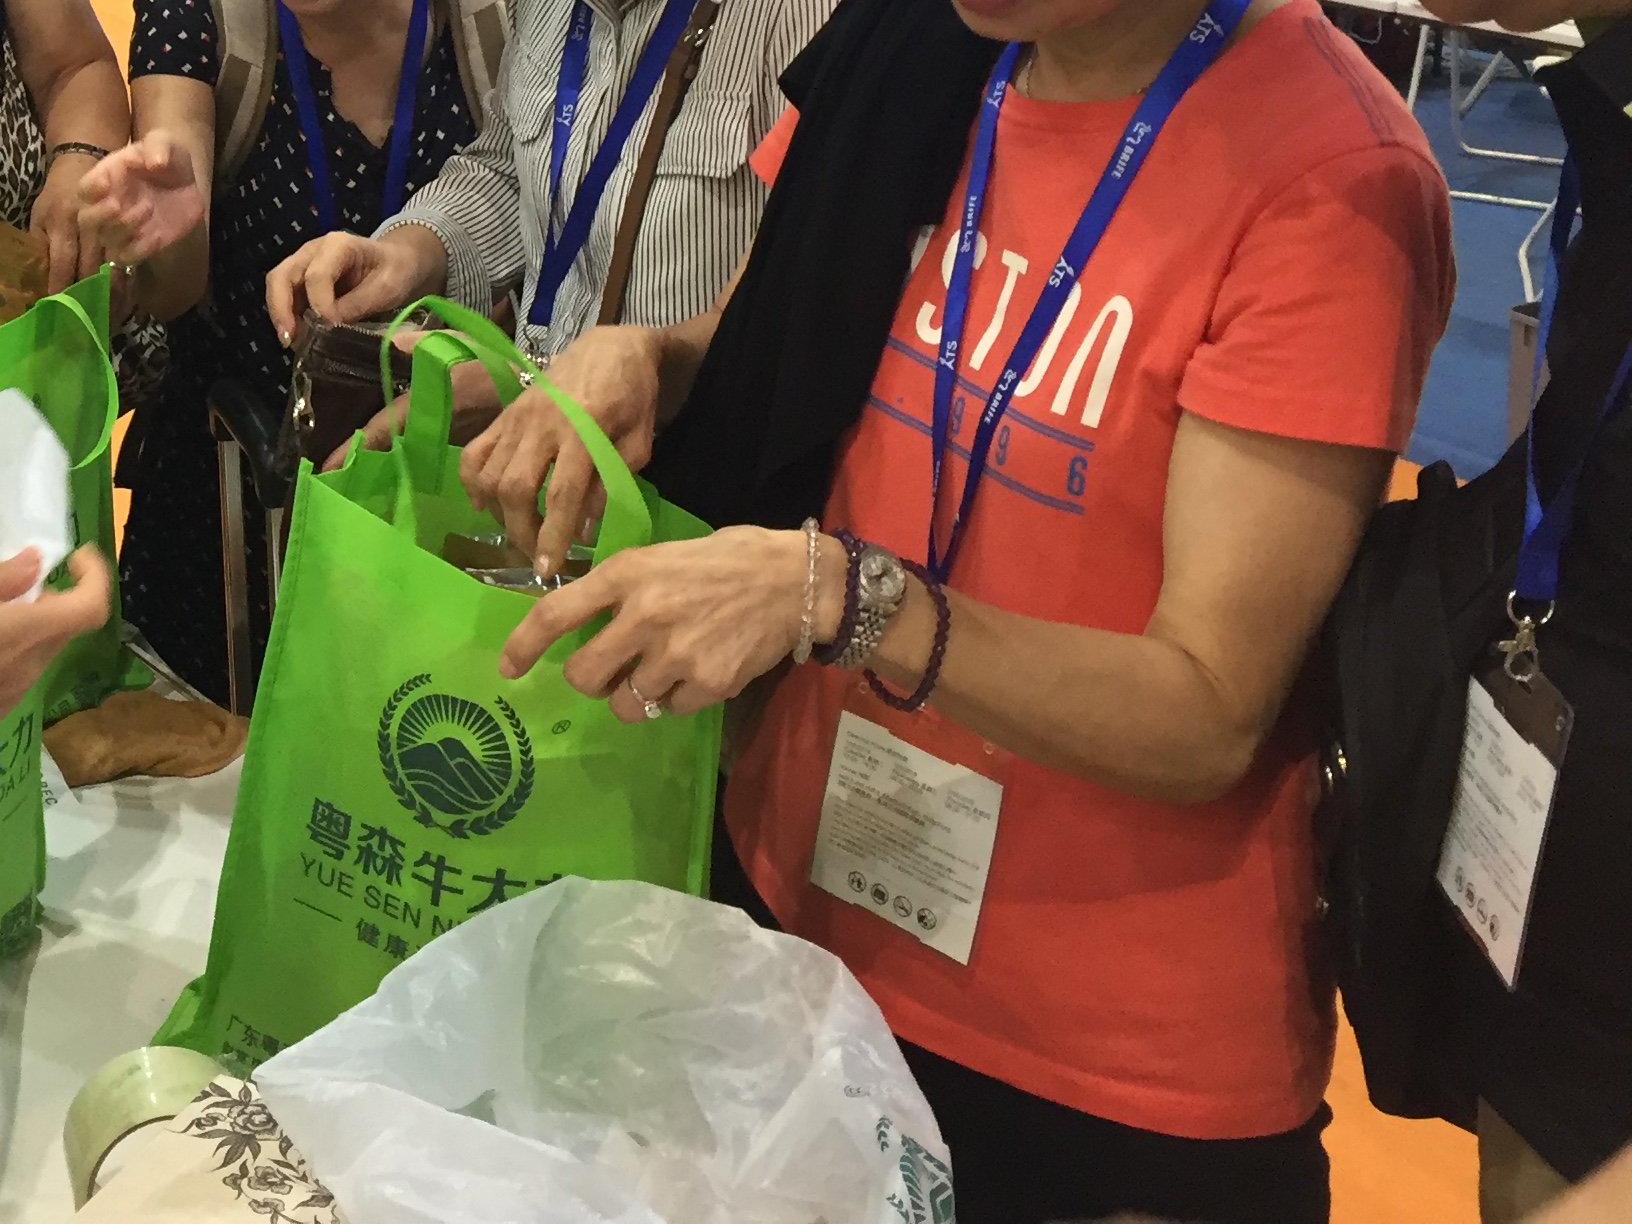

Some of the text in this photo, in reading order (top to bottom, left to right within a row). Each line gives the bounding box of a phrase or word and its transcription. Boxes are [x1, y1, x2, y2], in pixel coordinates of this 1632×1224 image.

[300, 851, 354, 899] YUE
[363, 884, 422, 929] SEN
[306, 797, 563, 914] 粤森牛大
[356, 918, 421, 960] 健康
